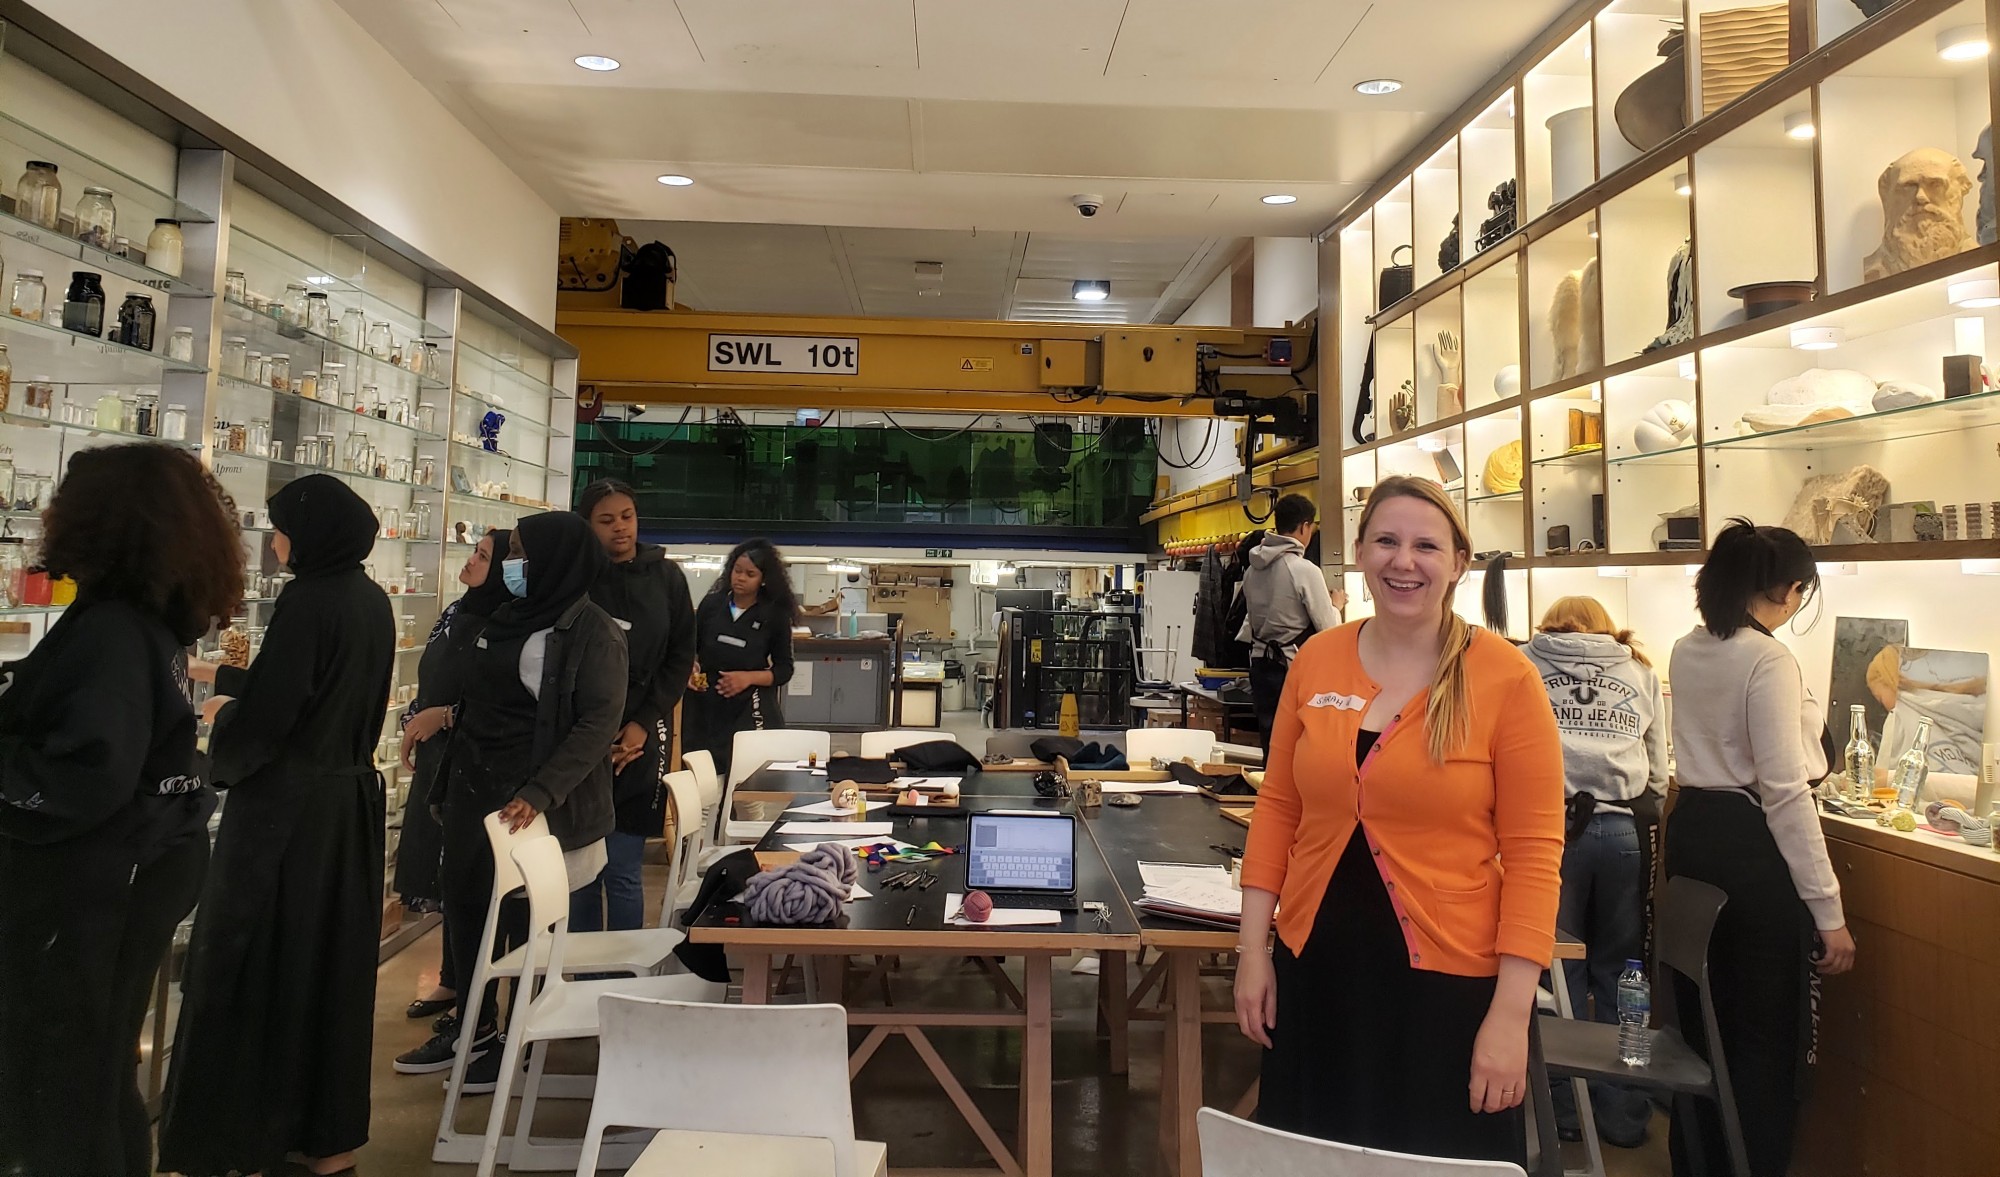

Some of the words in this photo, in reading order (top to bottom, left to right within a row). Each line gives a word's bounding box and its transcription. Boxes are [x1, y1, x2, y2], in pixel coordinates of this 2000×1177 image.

[714, 341, 782, 366] SWL
[807, 343, 855, 368] 10t
[213, 463, 243, 476] Aprons
[1587, 677, 1631, 697] RLGN
[1316, 695, 1344, 707] SARAH
[1588, 708, 1636, 729] JEANS
[656, 719, 668, 742] ute
